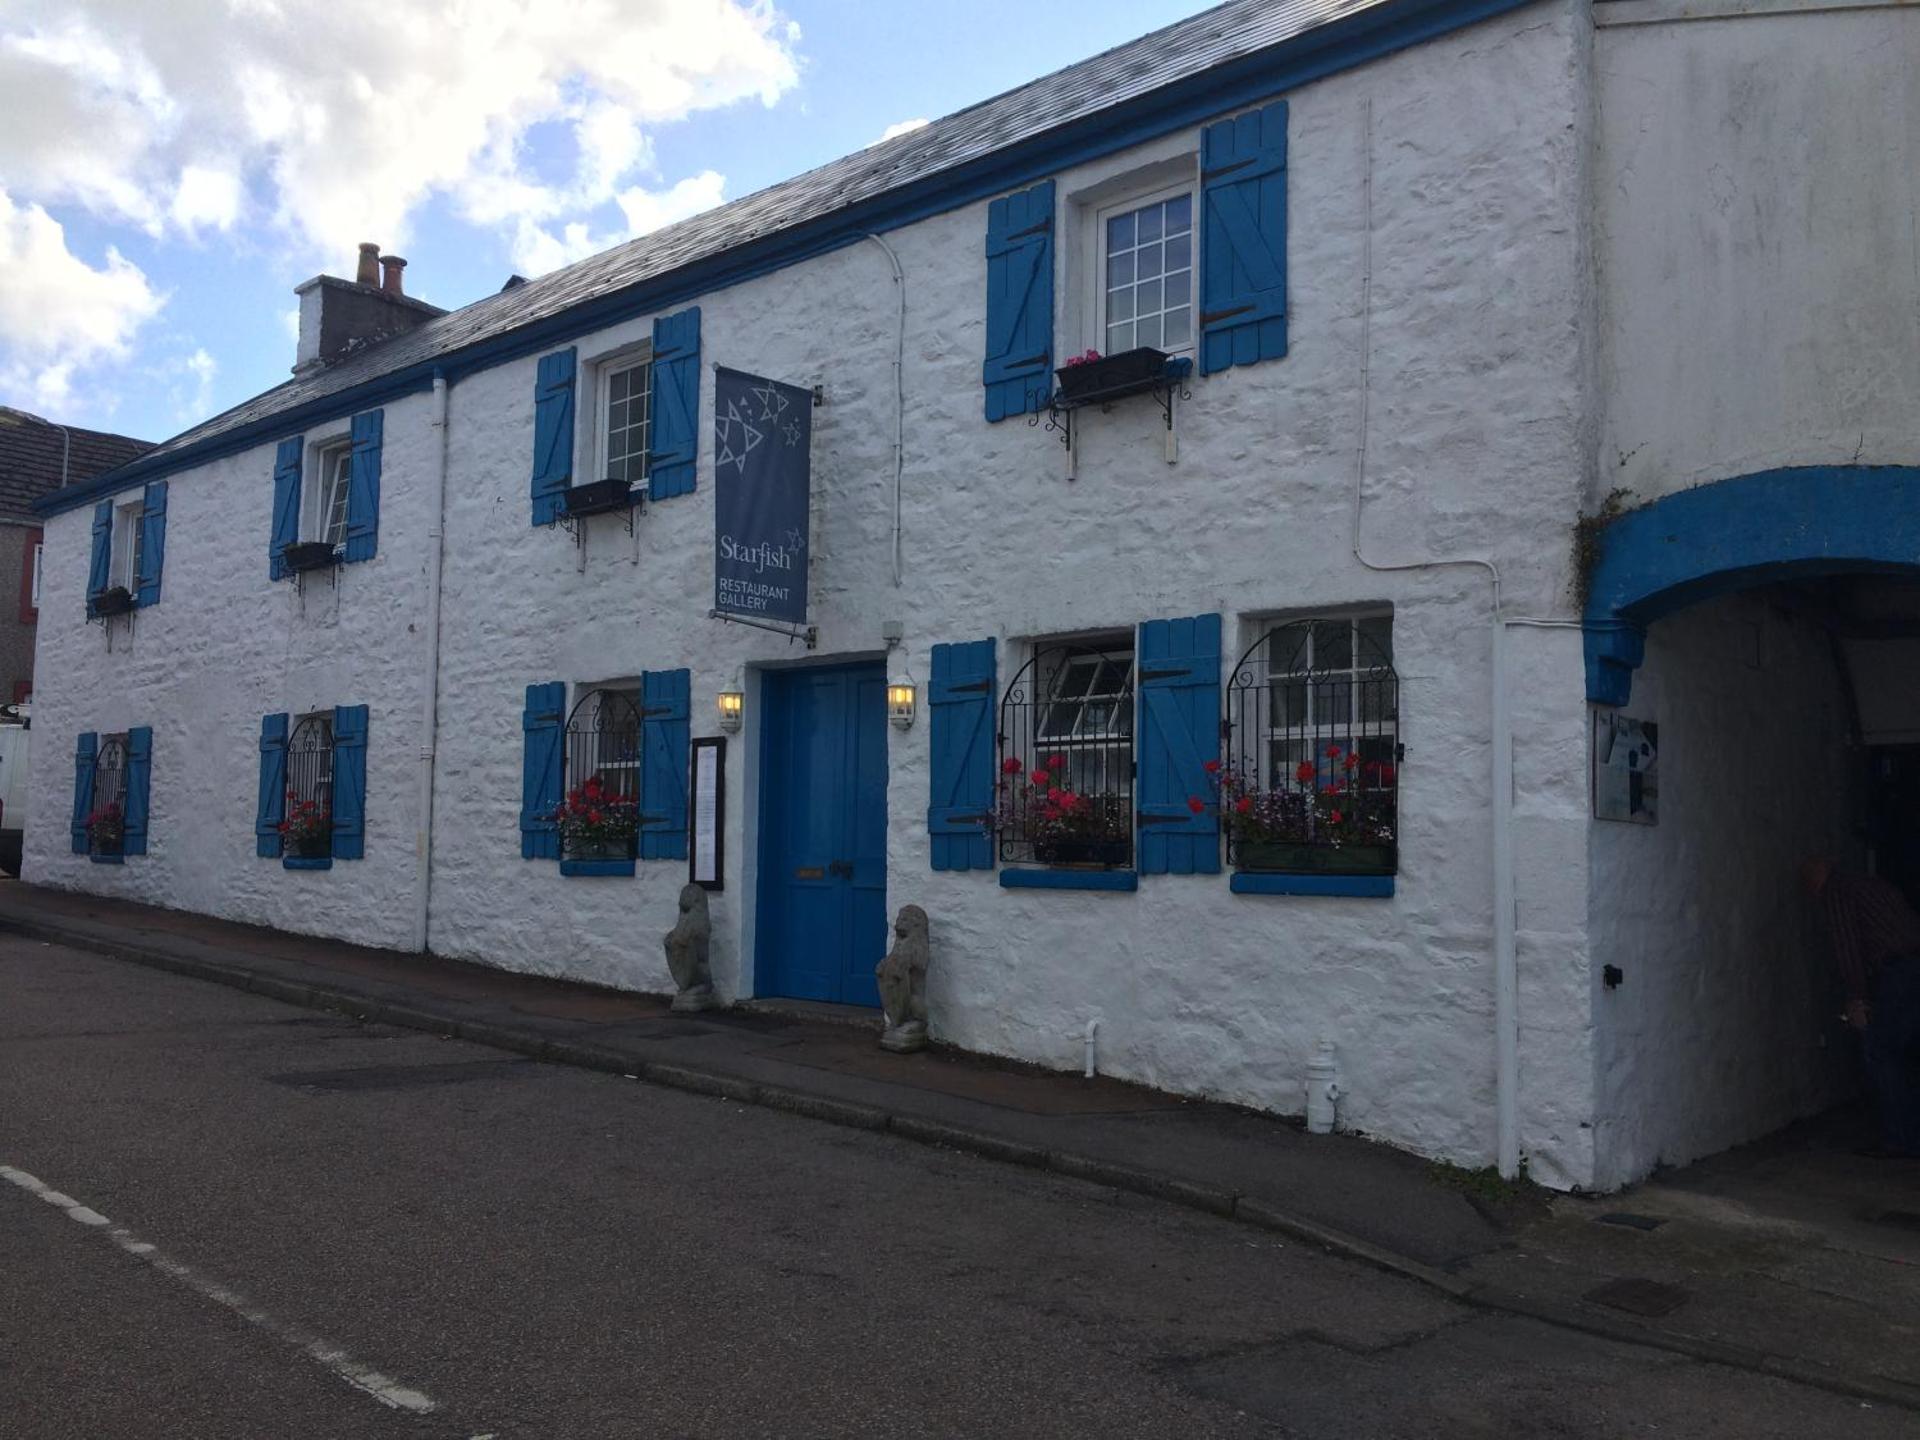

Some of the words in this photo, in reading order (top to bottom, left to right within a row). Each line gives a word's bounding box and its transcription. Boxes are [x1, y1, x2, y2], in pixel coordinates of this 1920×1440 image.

[720, 534, 791, 573] Starfish
[718, 592, 768, 610] GALLERY
[719, 577, 790, 601] RESTAURANT
